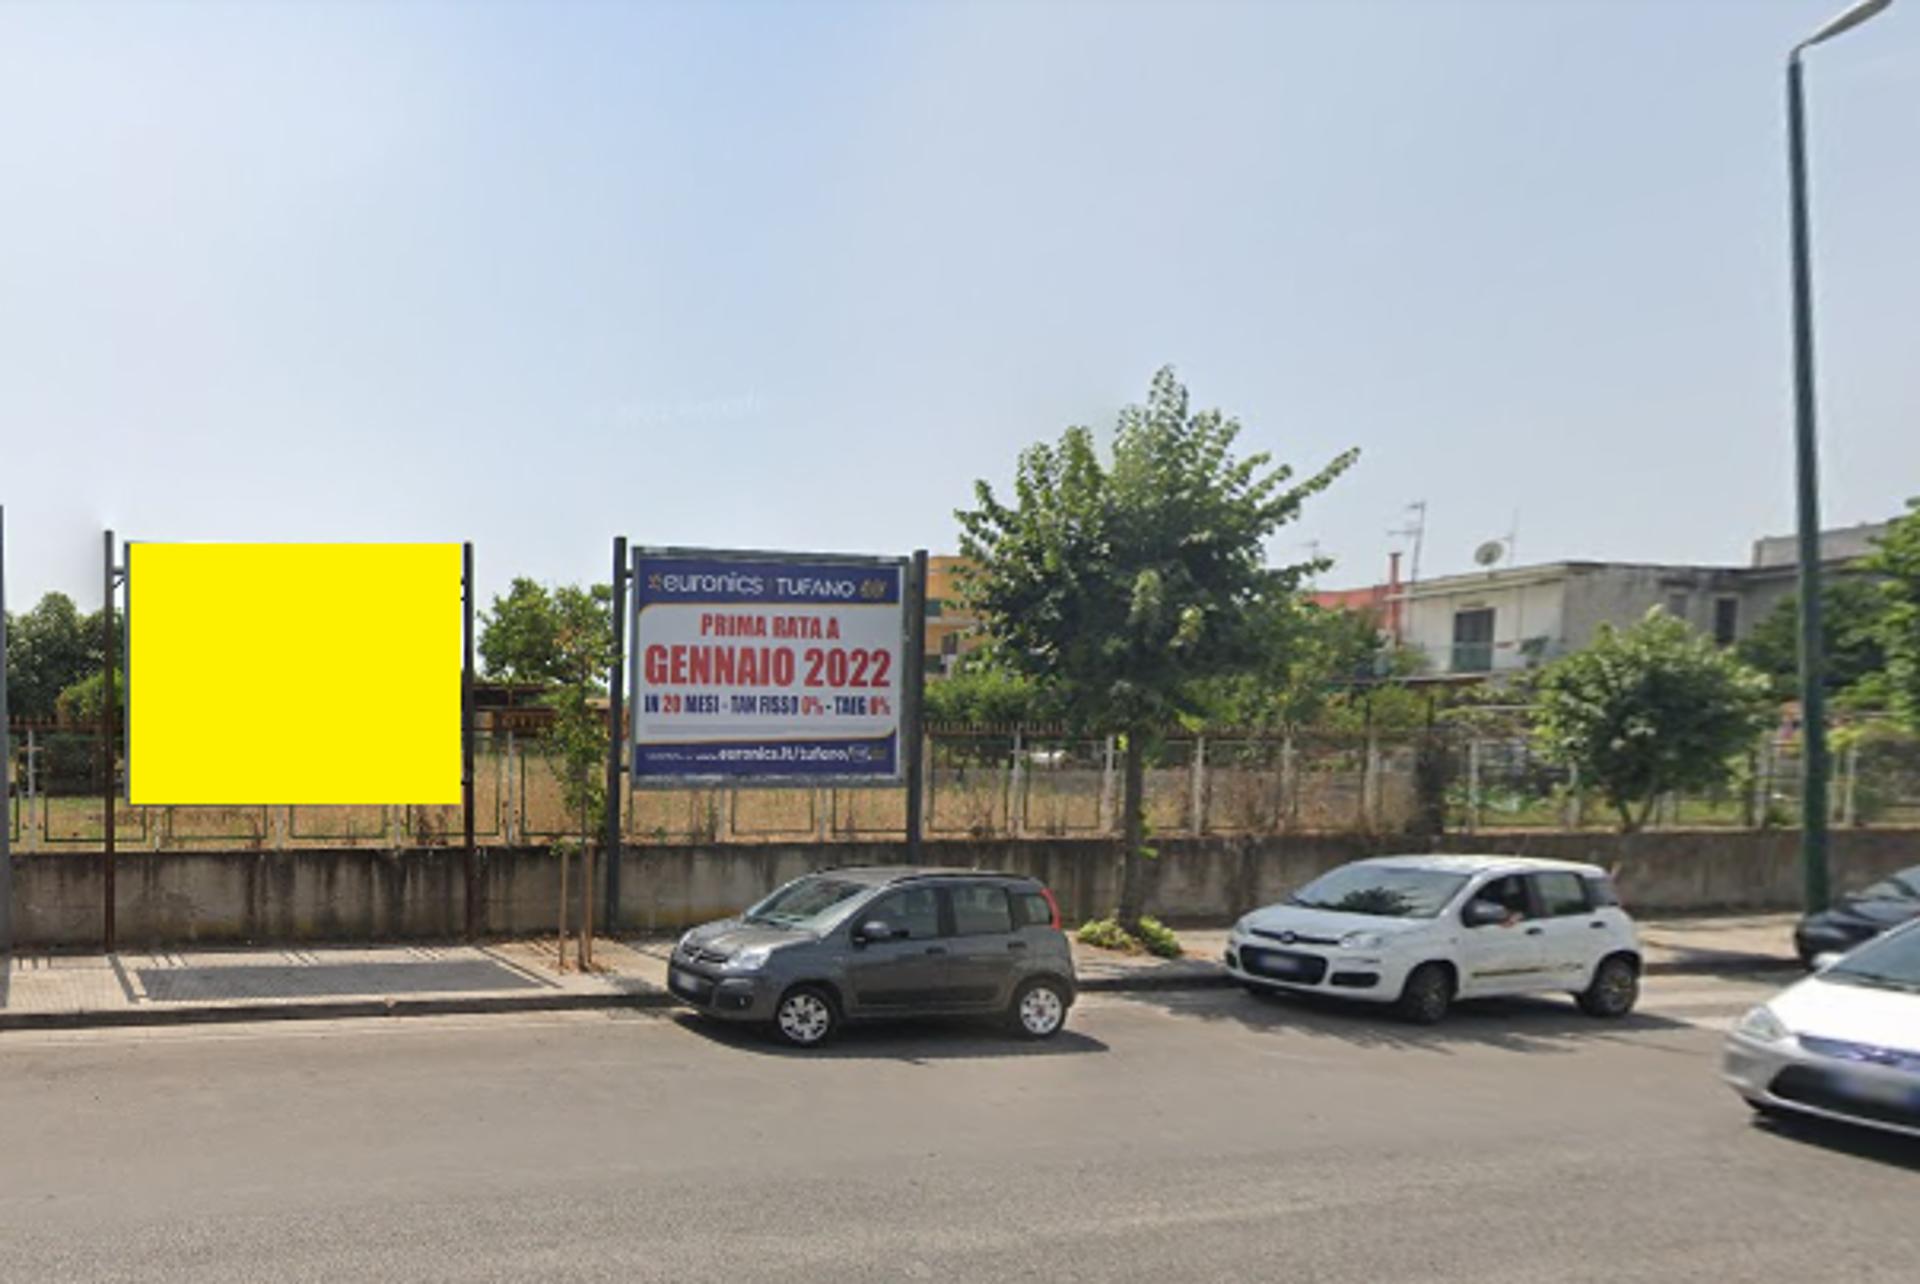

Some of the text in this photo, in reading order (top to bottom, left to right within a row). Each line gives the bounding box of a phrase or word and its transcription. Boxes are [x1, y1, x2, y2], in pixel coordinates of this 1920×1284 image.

[663, 572, 856, 597] euronics TUFANO
[700, 613, 840, 639] PRIMA RATA A
[644, 644, 891, 688] GENNAIO 2022
[644, 694, 659, 714] IN
[663, 695, 681, 714] 20
[684, 695, 719, 715] MESI
[759, 695, 798, 716] FISSO
[801, 696, 823, 716] 0%
